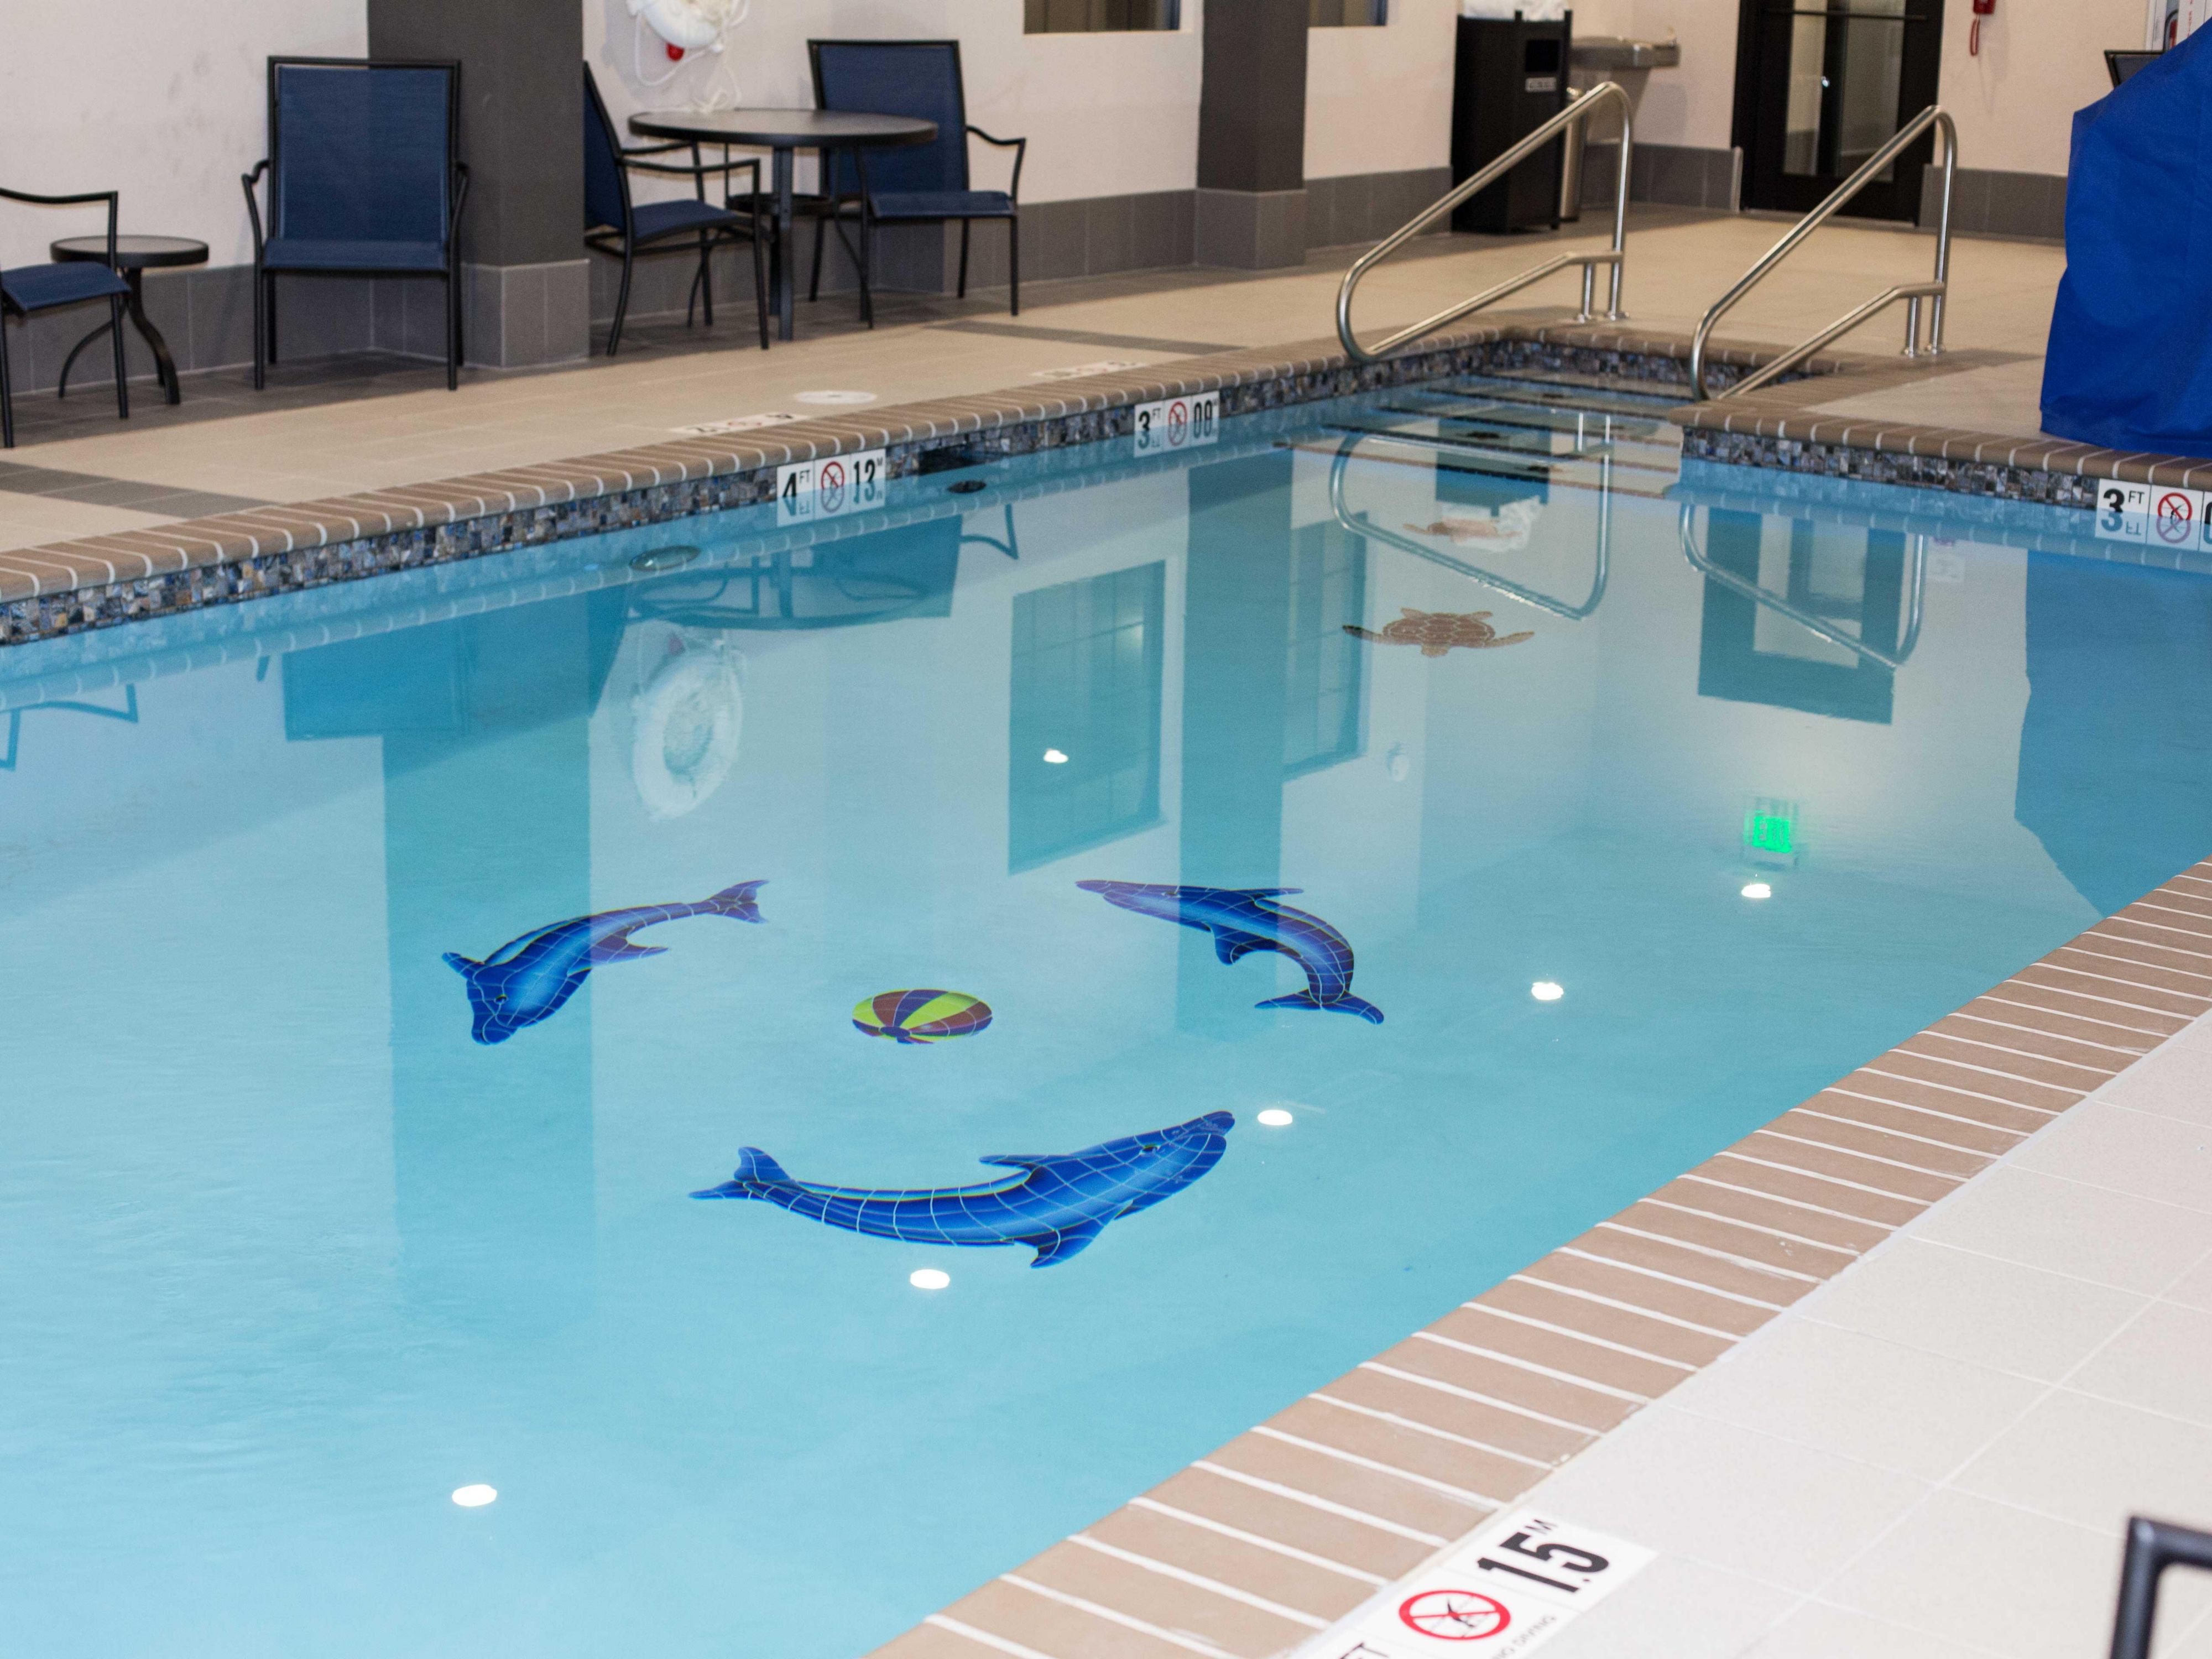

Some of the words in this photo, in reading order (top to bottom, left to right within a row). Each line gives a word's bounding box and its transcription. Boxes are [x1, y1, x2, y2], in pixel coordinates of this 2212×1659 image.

[799, 469, 810, 484] FT
[2128, 491, 2145, 504] FT
[1524, 1519, 1558, 1535] M
[1477, 1532, 1609, 1593] 1.5
[1512, 1615, 1558, 1646] DIVING
